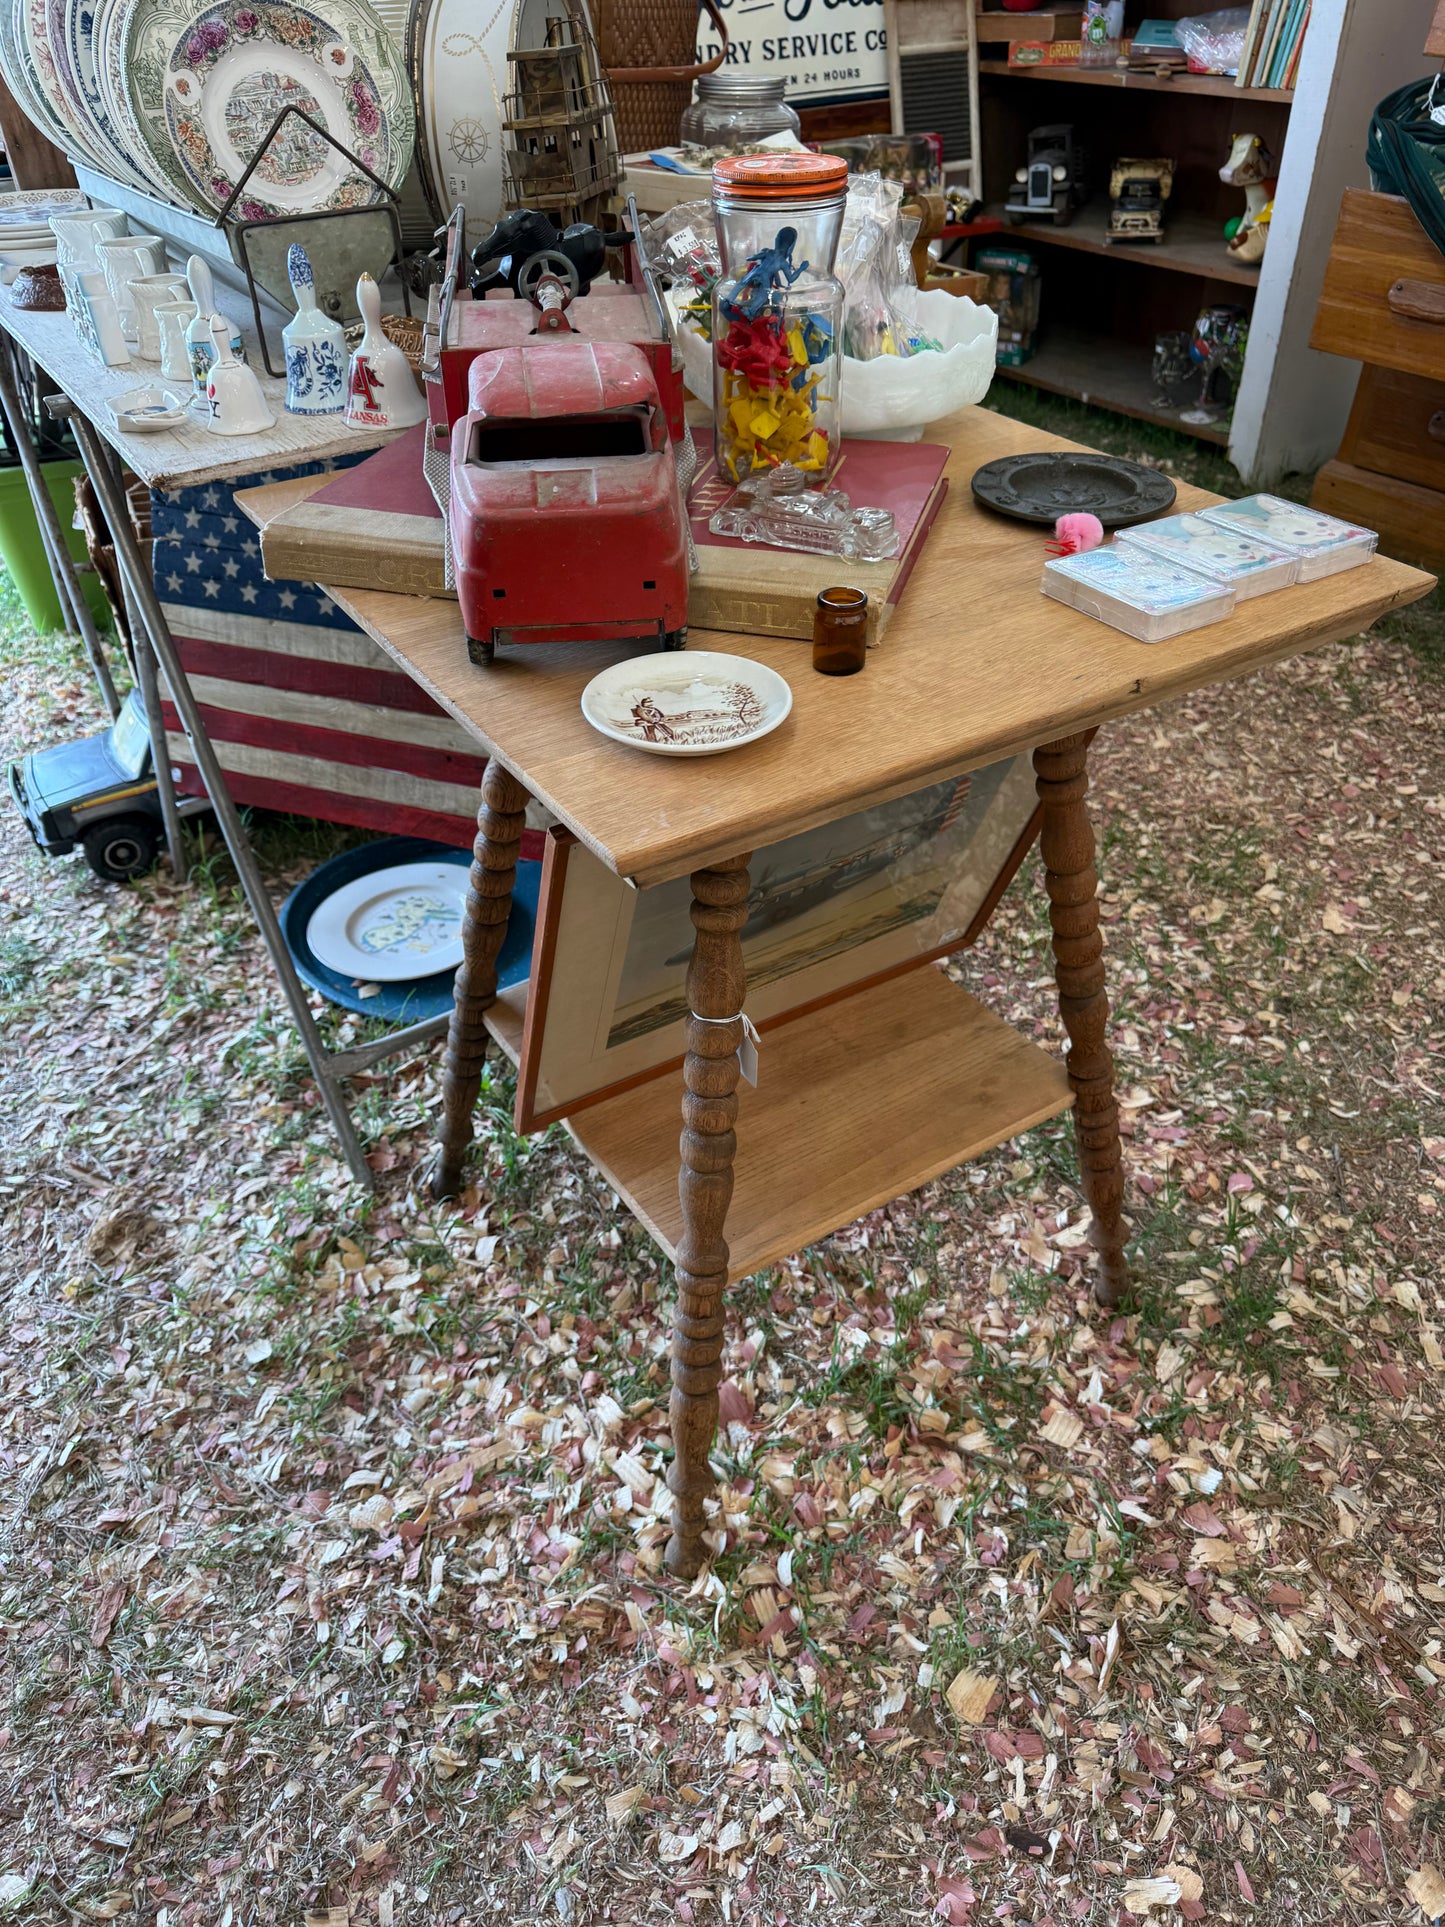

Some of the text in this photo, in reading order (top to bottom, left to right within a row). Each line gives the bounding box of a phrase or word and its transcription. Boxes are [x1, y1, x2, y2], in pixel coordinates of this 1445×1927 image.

[762, 31, 857, 61] SERVICE
[804, 72, 818, 84] 24
[823, 68, 861, 82] HOURS
